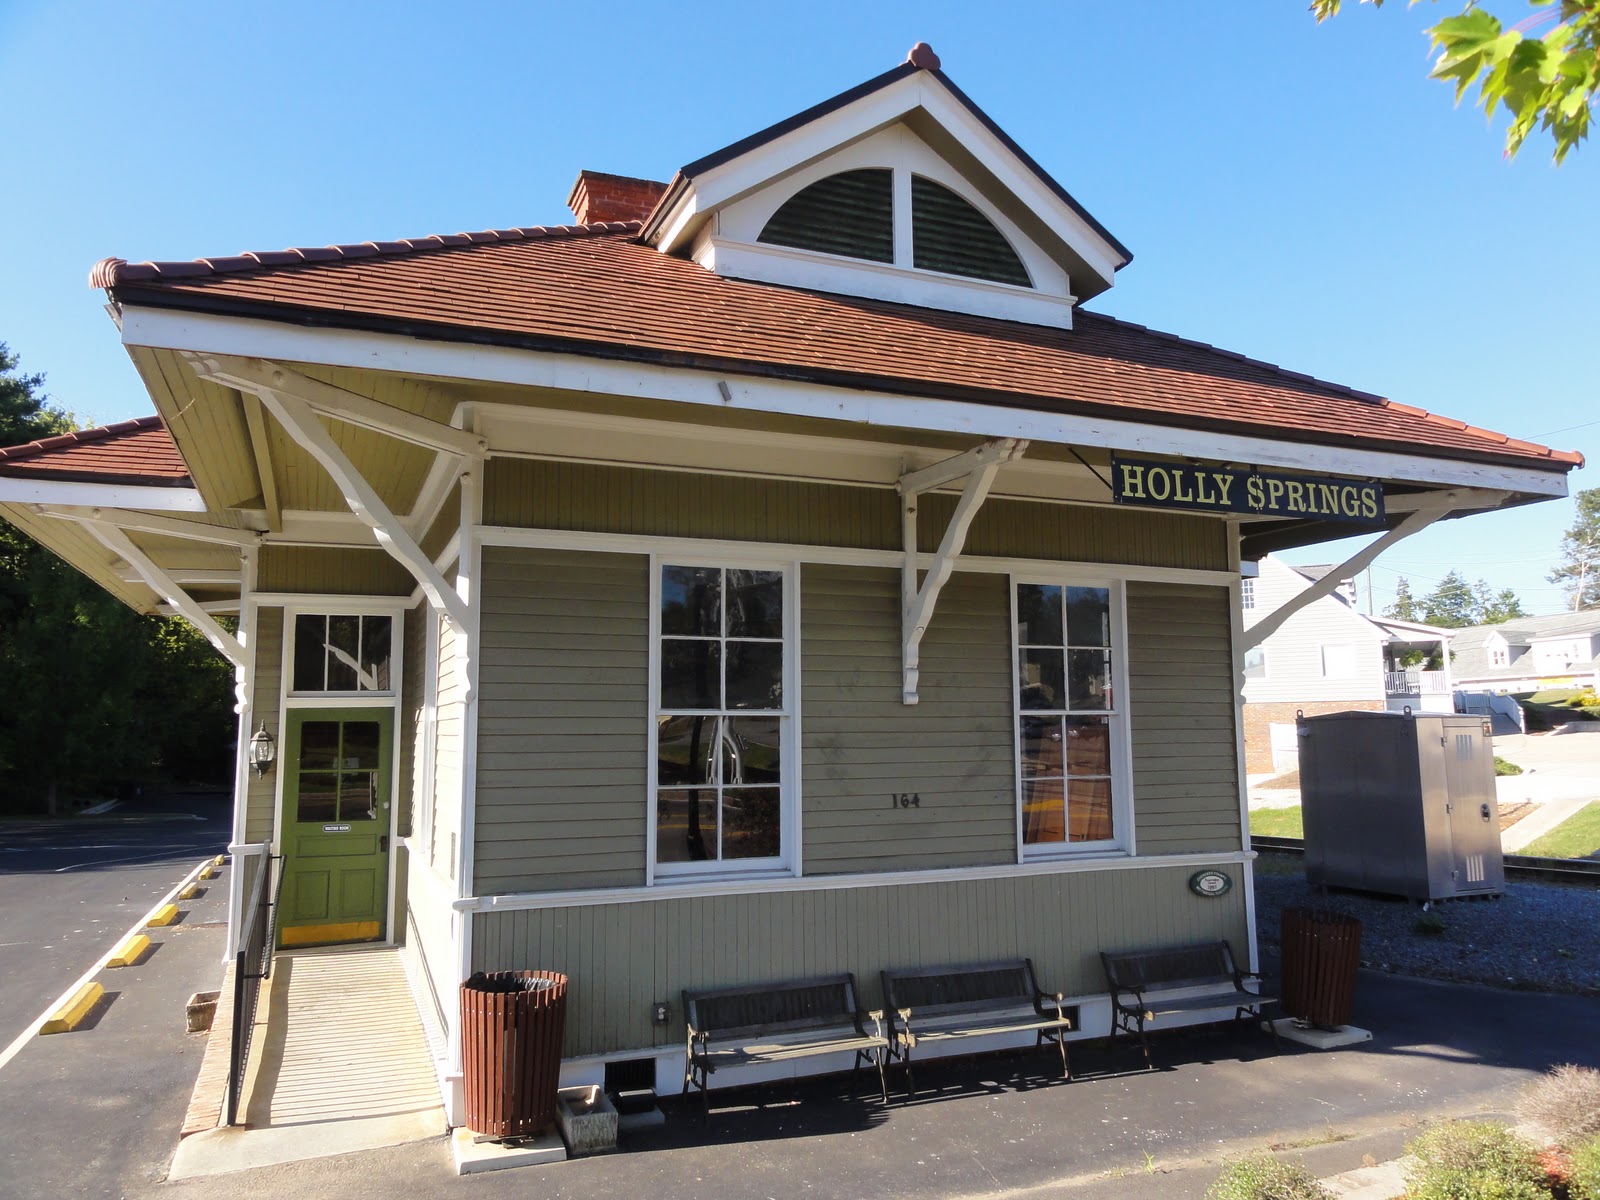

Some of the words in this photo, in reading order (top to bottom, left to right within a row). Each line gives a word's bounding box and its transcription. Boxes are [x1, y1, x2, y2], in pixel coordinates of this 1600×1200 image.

[1120, 464, 1234, 505] HOLLY
[1247, 475, 1378, 518] SPRINGS
[892, 793, 920, 809] 164
